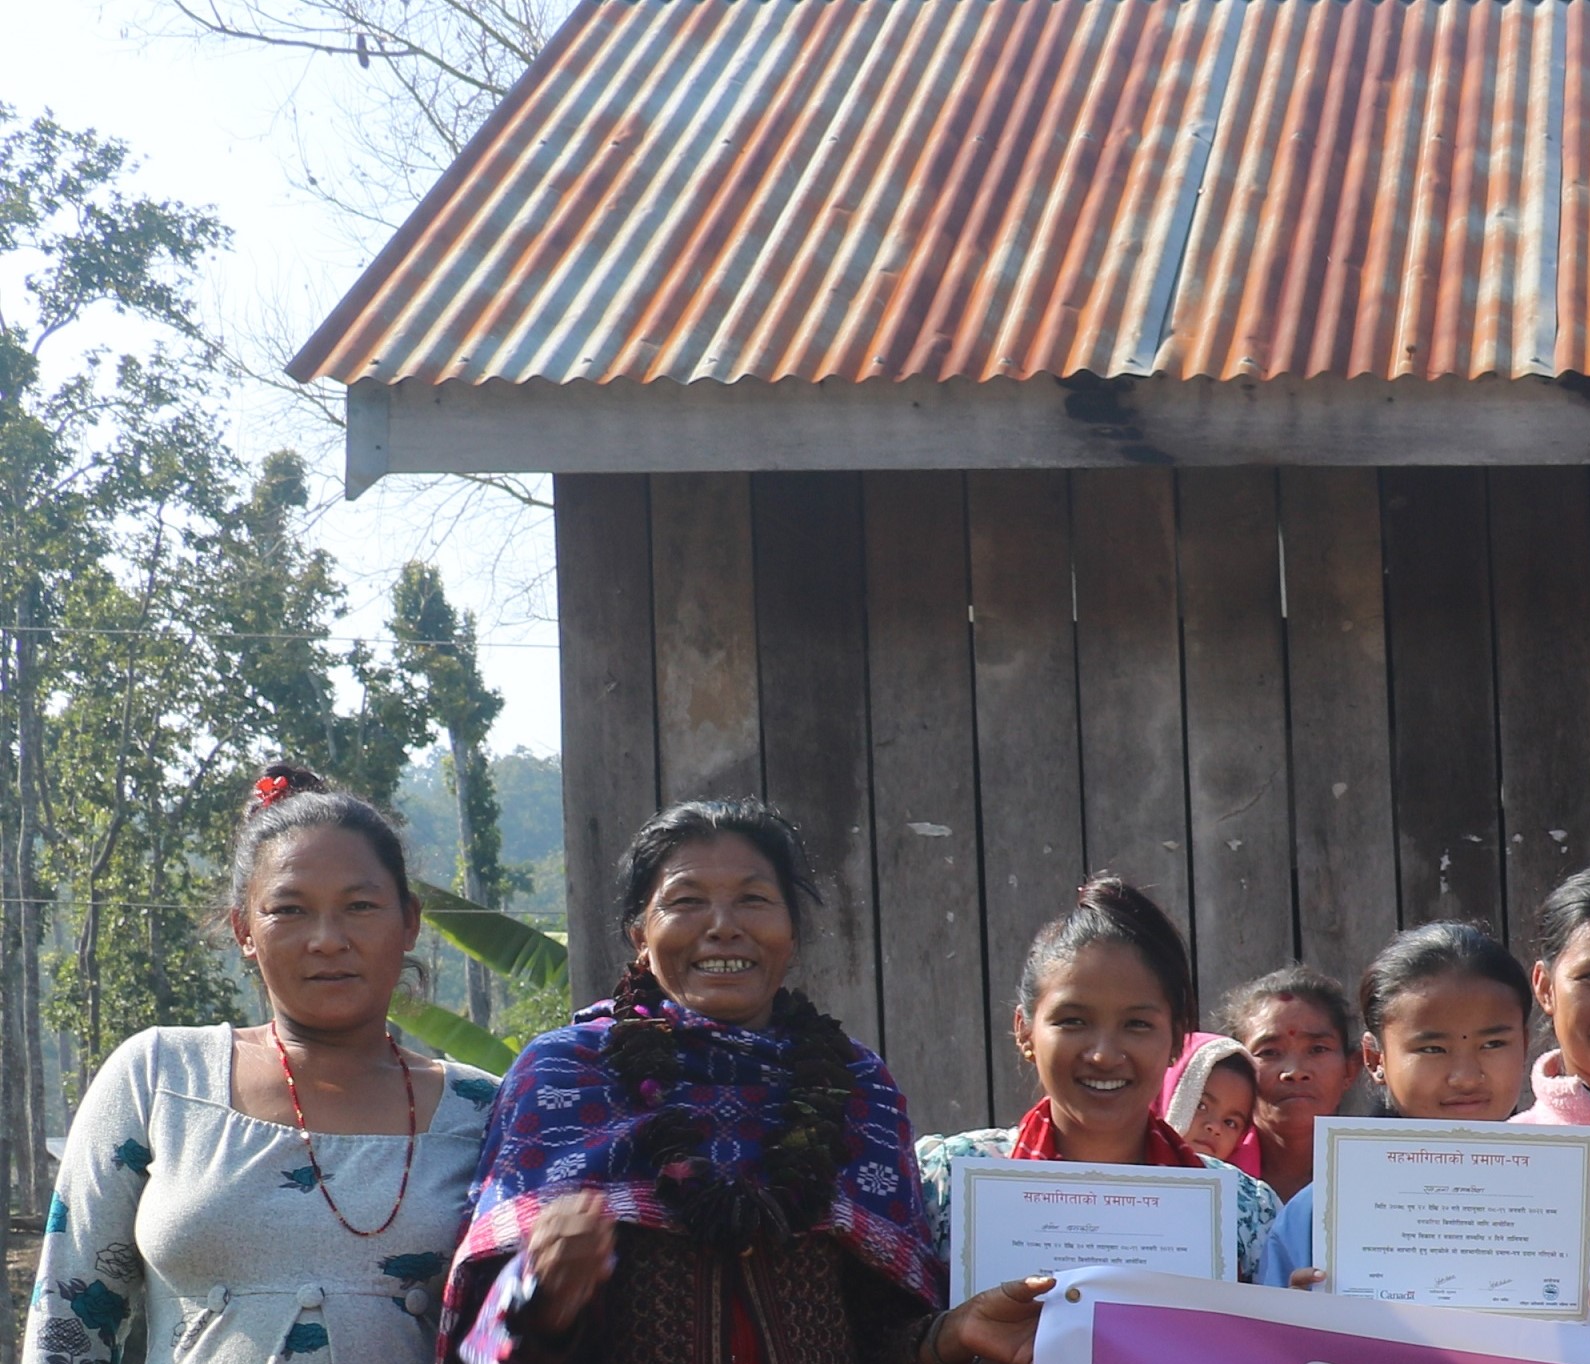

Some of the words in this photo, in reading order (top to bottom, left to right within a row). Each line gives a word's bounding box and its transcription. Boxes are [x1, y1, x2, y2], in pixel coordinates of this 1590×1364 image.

[1387, 1149, 1464, 1166] सहभागिताको
[1472, 1152, 1530, 1167] प्रमाण-पत्र
[1023, 1191, 1097, 1206] सहभागिताको
[1104, 1193, 1159, 1208] प्रमाण-पत्र
